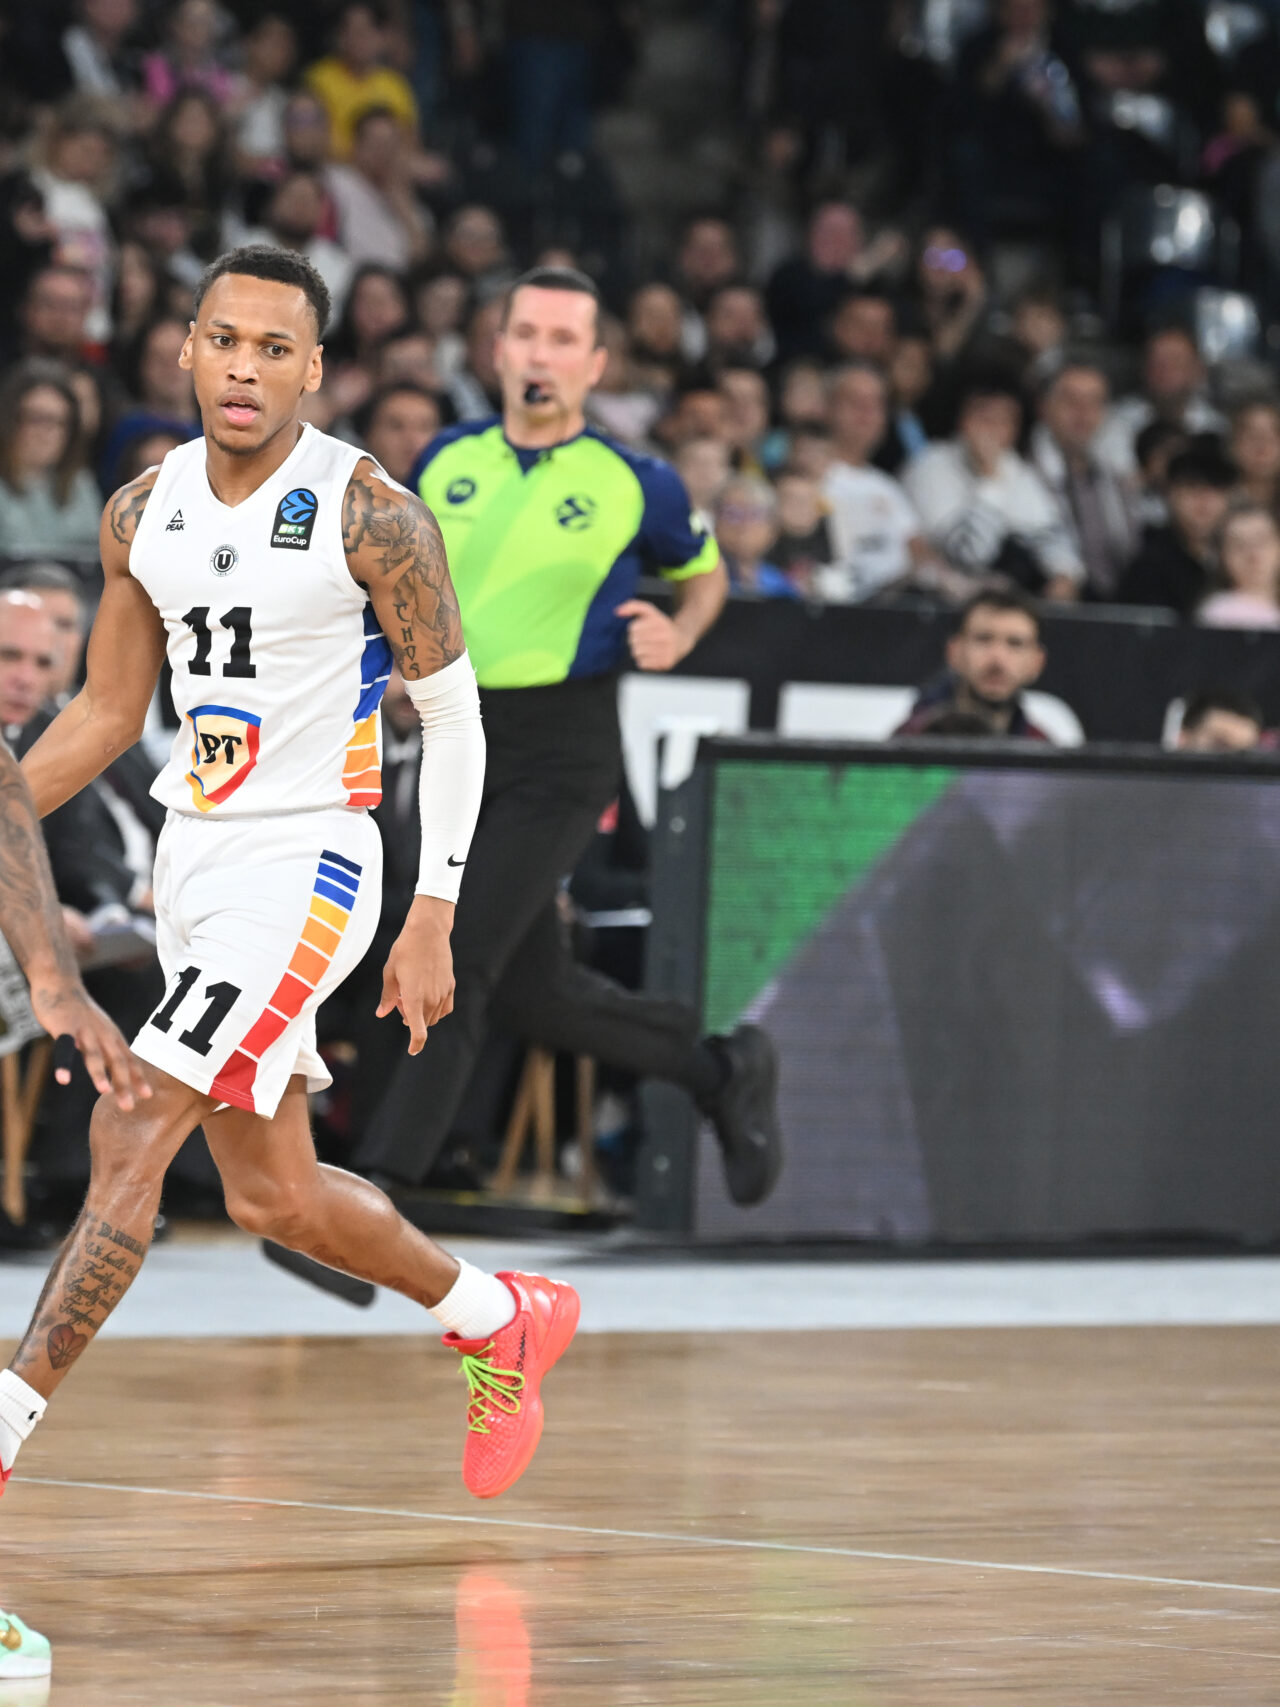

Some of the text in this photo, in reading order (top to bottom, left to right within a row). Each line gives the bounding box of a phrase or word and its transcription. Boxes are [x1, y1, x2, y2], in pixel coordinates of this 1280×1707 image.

[165, 522, 186, 532] PEAK
[273, 534, 308, 547] EuroCup
[181, 606, 257, 679] 11
[149, 965, 243, 1058] 11
